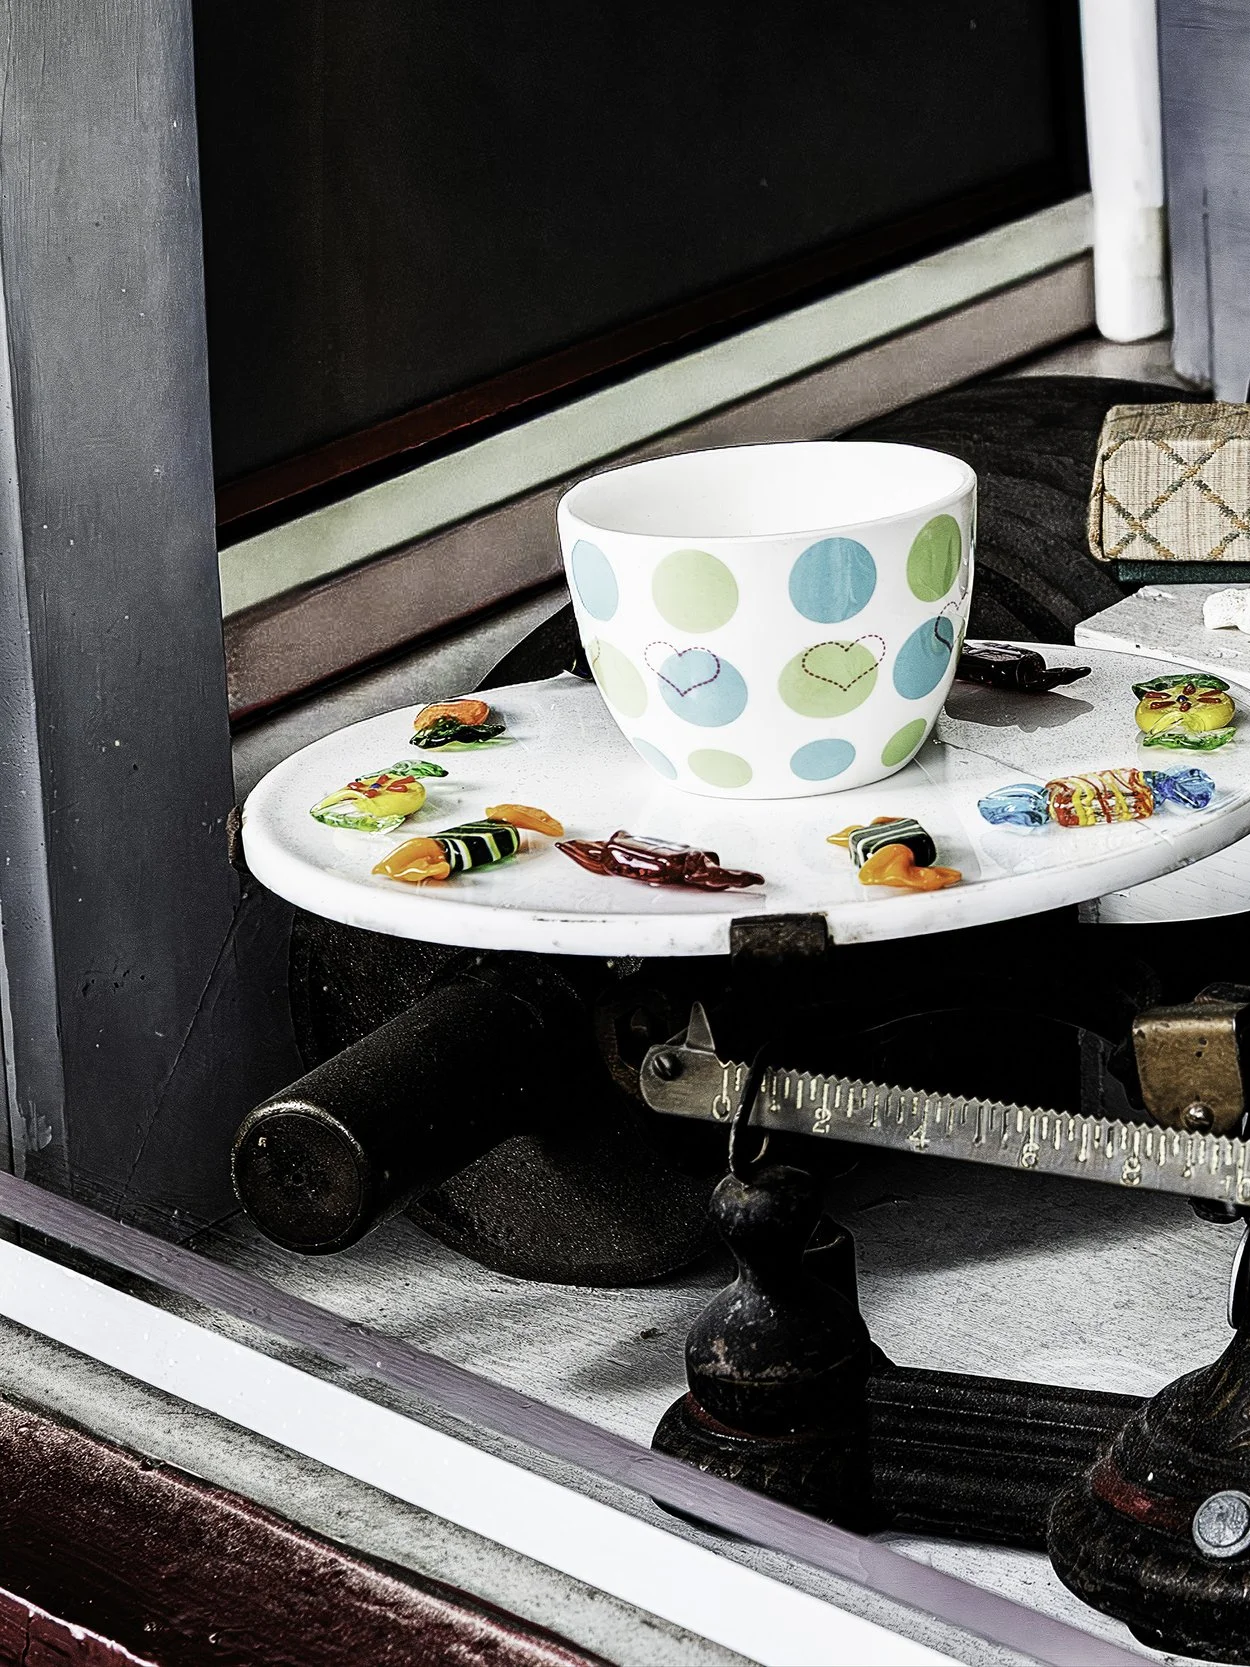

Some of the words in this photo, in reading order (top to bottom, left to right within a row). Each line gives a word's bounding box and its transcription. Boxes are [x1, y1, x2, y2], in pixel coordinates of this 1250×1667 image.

[812, 1107, 832, 1134] 2
[907, 1124, 930, 1152] 4
[1121, 1156, 1141, 1187] 8
